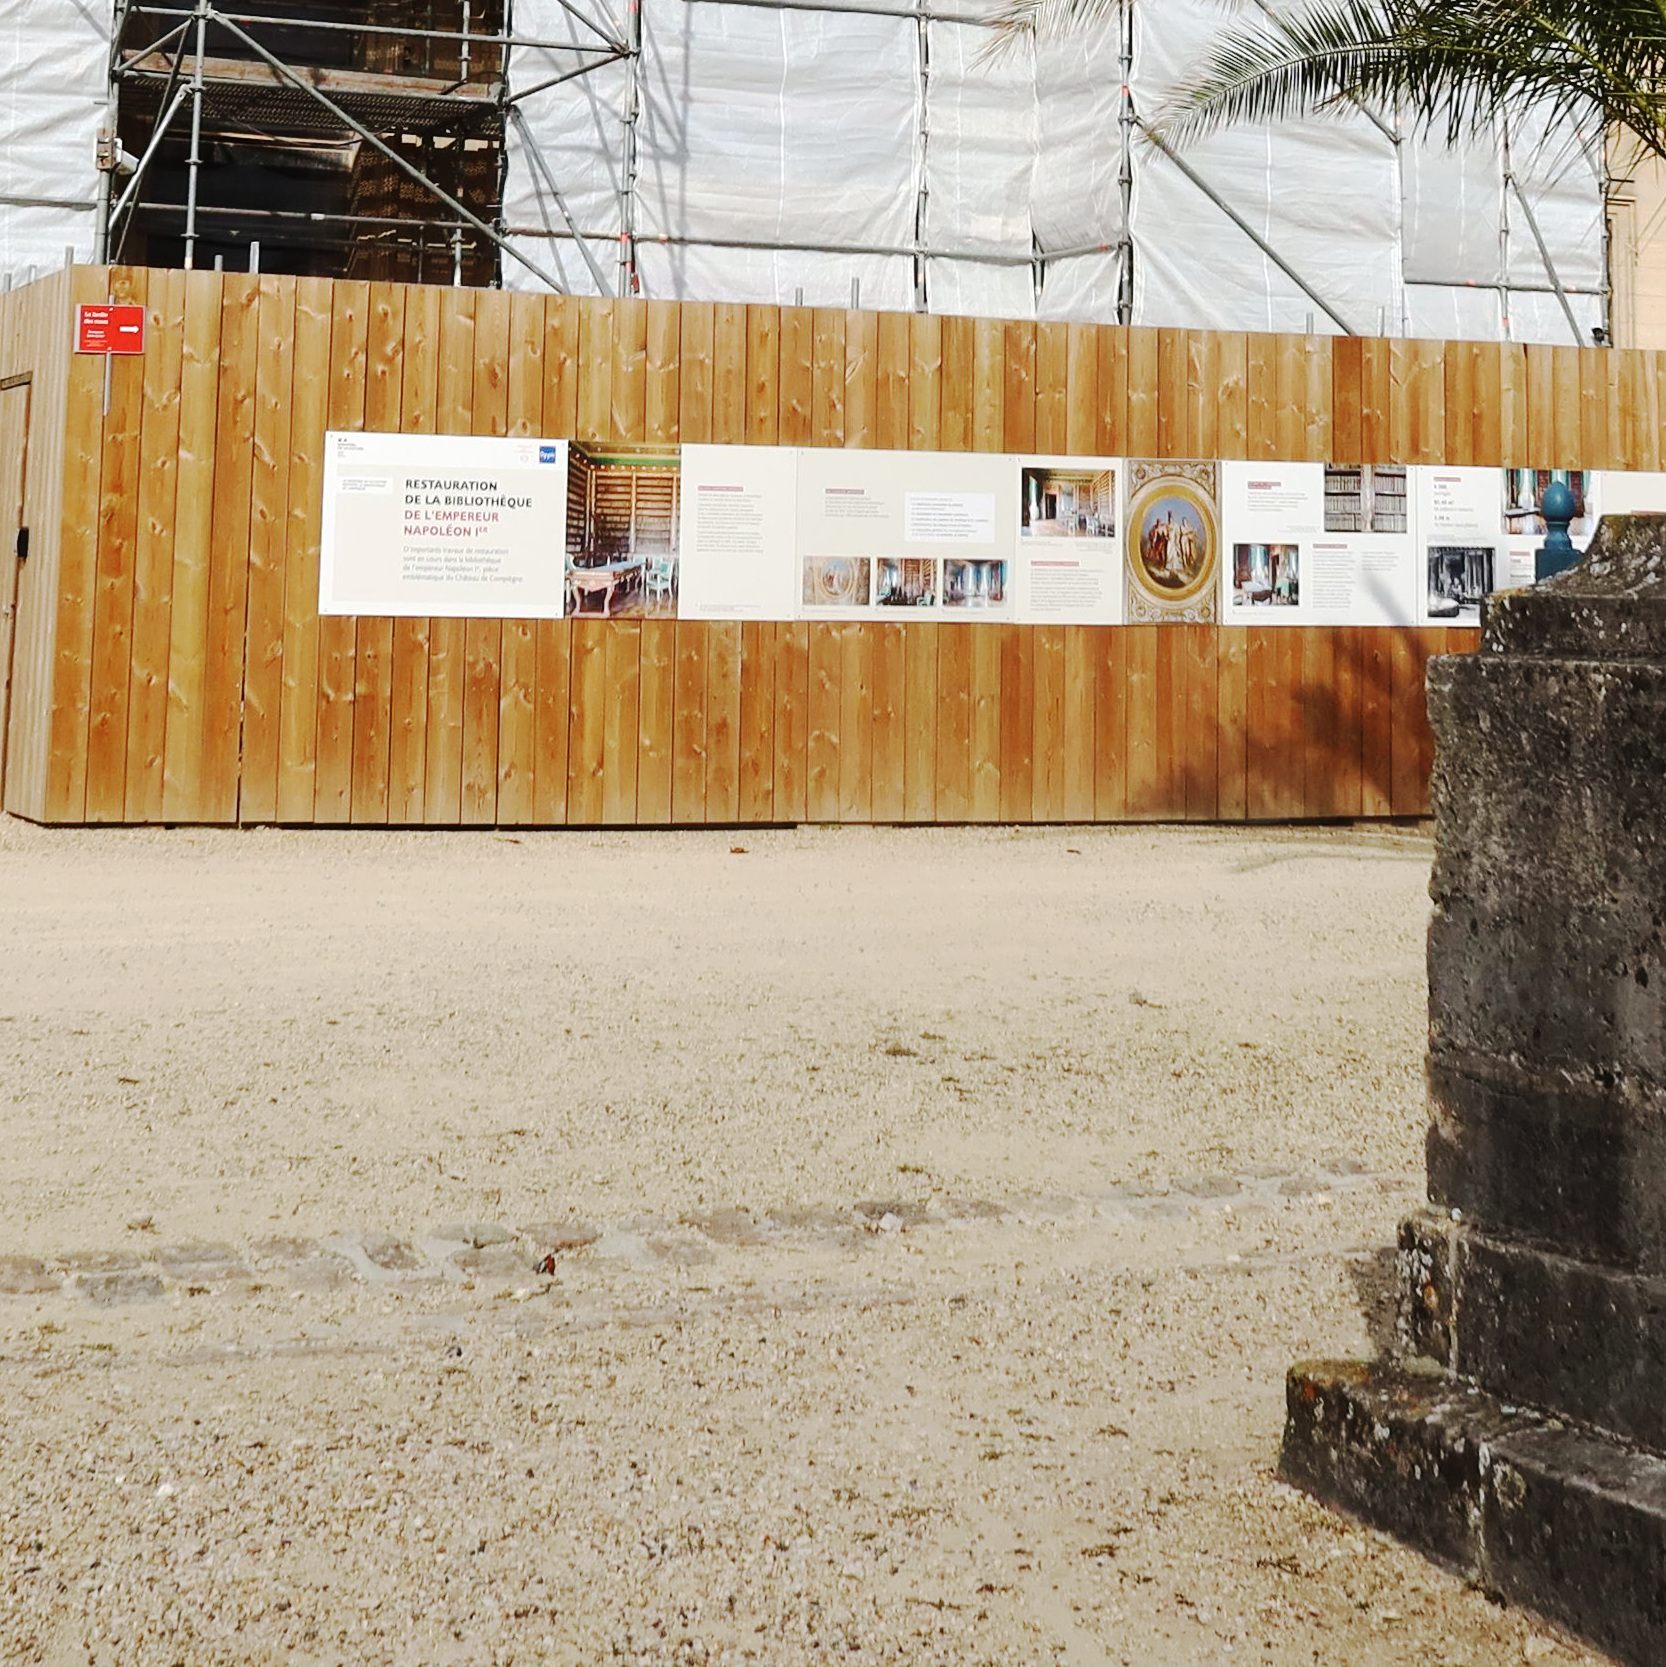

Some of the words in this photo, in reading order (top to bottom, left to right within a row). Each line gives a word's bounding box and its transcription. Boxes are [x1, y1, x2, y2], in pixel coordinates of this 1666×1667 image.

[405, 479, 498, 491] RESTAURATION
[405, 495, 421, 504] DE
[425, 495, 441, 505] LA
[445, 494, 533, 509] BIBLIOTHÈQUE
[404, 510, 421, 520] DE
[425, 510, 499, 522] L'EMPEREUR
[404, 524, 472, 536] NAPOLÉON
